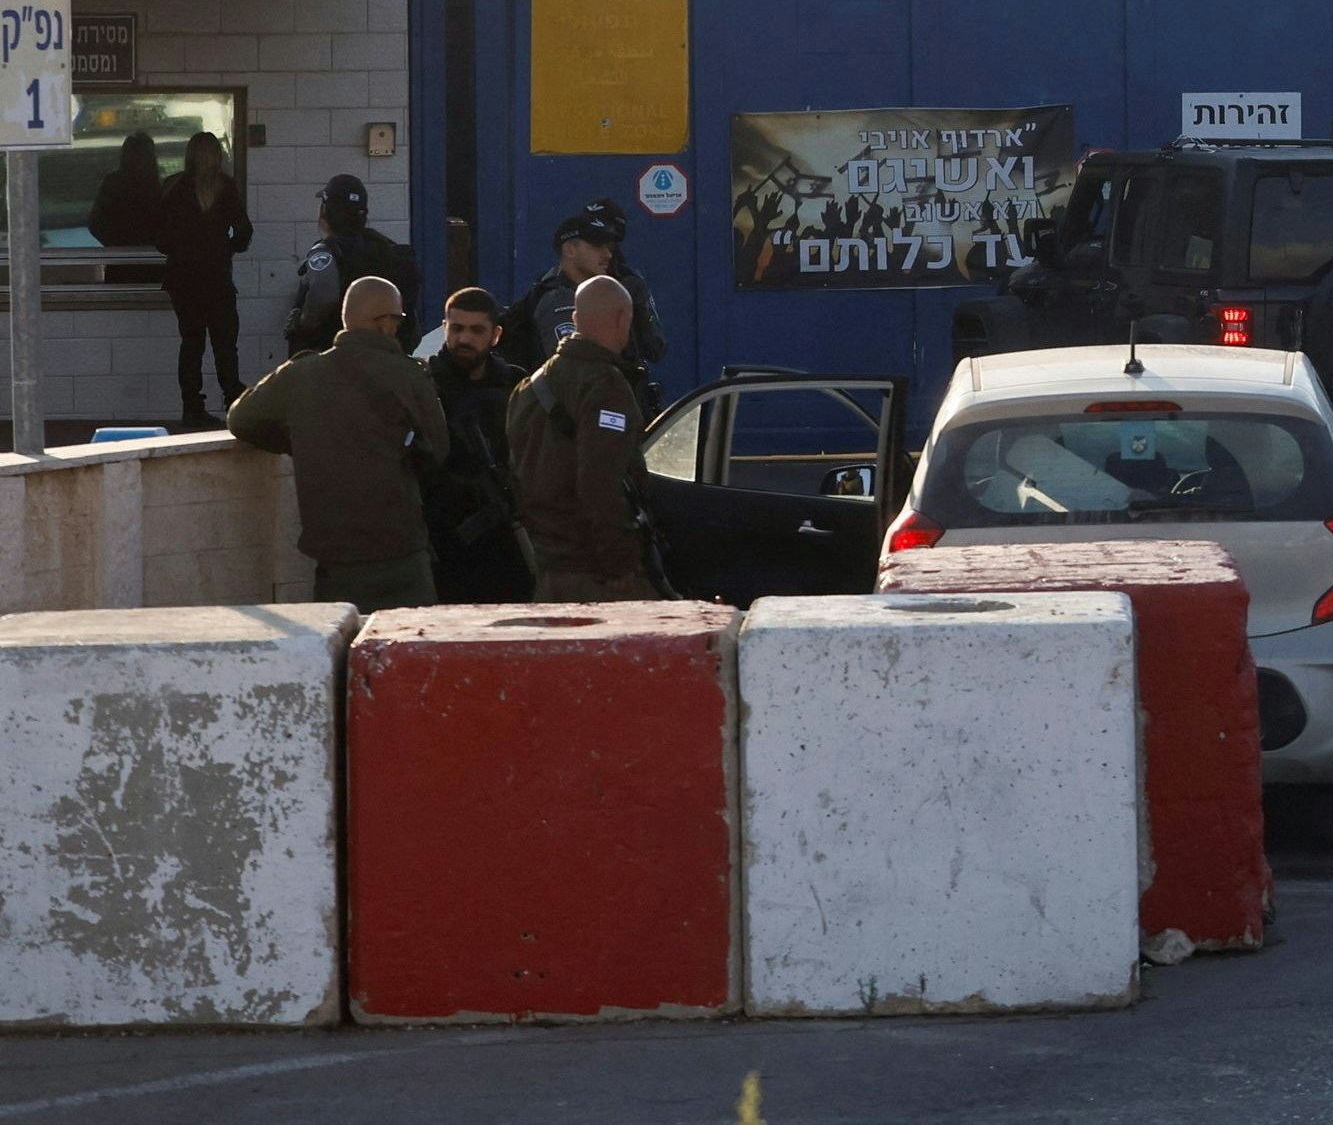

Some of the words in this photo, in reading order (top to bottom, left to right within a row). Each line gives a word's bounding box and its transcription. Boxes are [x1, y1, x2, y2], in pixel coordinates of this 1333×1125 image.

[77, 26, 129, 44] מסירת
[26, 79, 44, 129] 1
[1193, 104, 1290, 125] זהירות
[857, 128, 932, 151] אויבי
[848, 155, 1035, 194] ואשיגם
[904, 199, 984, 223] אשוב
[992, 195, 1039, 221] ולא
[972, 233, 1036, 268] עד
